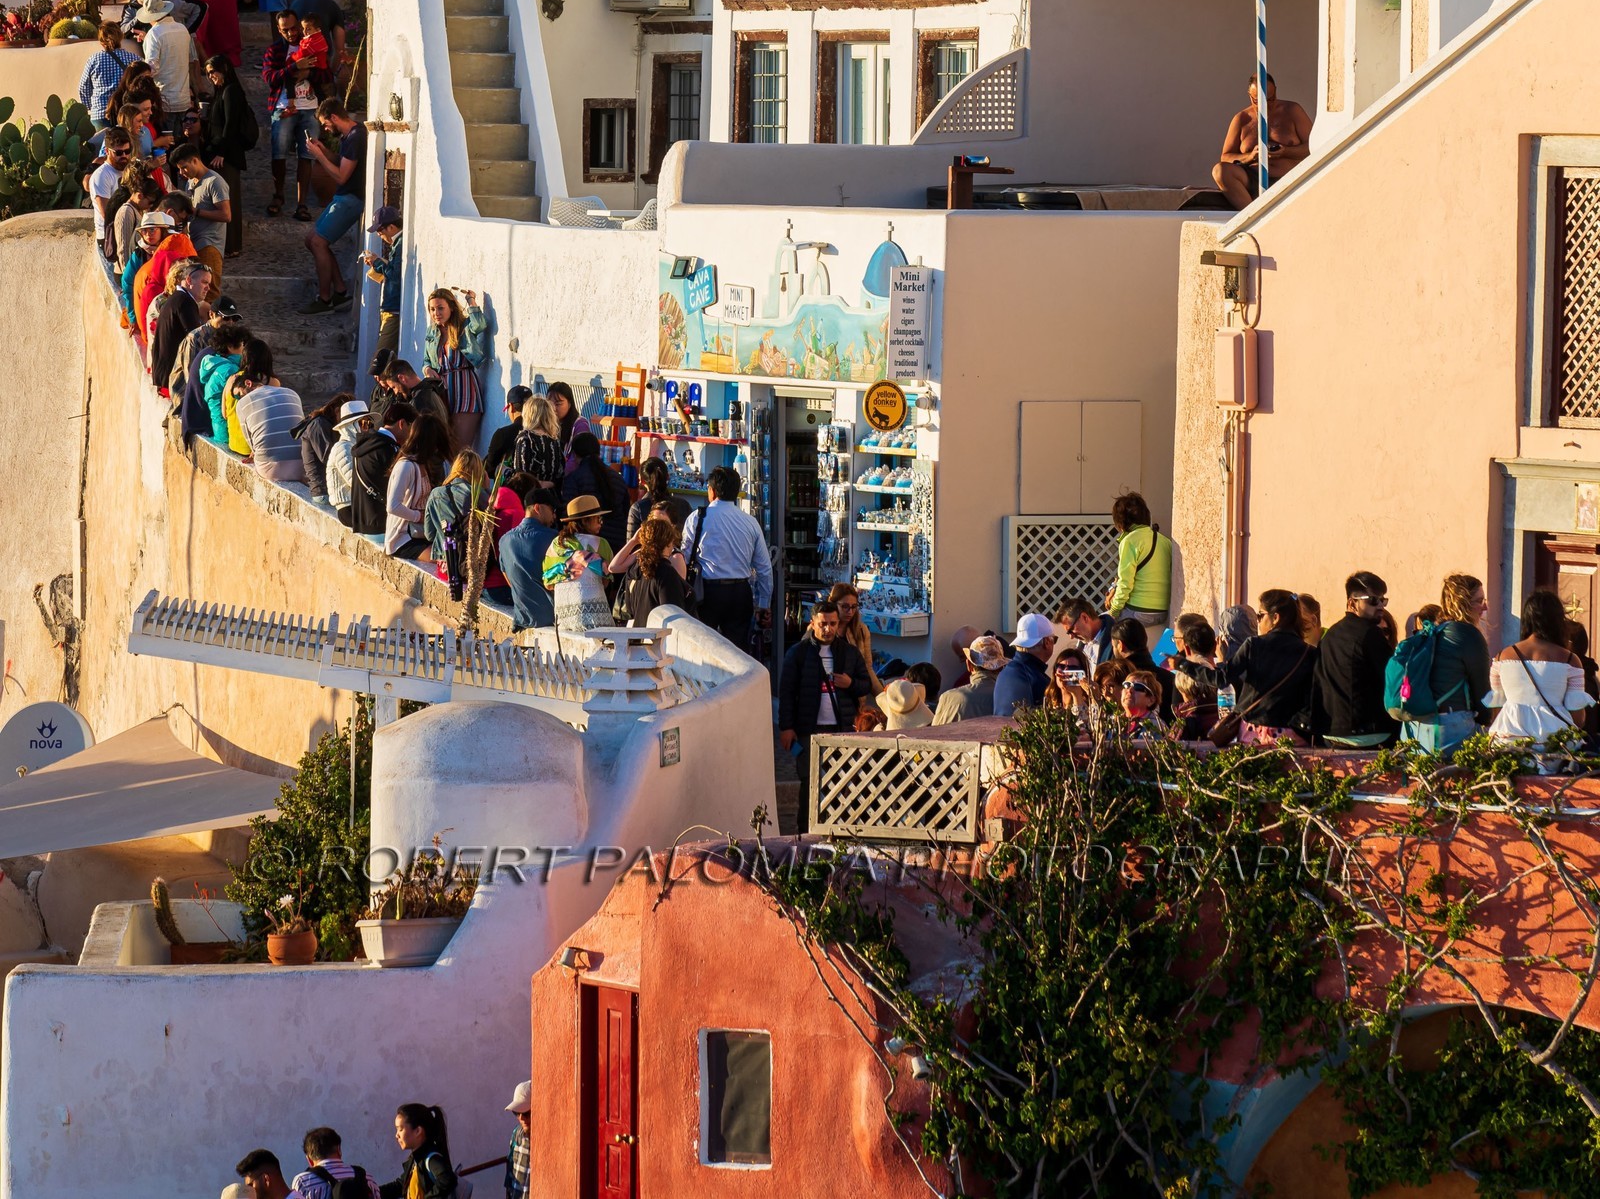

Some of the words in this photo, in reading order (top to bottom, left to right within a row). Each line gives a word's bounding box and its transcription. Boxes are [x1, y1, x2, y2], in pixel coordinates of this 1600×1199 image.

[900, 271, 920, 281] Mini
[893, 282, 925, 291] Market
[689, 285, 711, 308] CAVE
[729, 288, 743, 302] MINI
[902, 296, 915, 304] wines
[724, 304, 749, 321] MARKET
[893, 328, 921, 337] champagnes
[889, 338, 904, 346] sorbet
[905, 338, 925, 346] cocktails
[894, 359, 918, 367] traditional
[895, 370, 916, 379] products
[876, 391, 897, 399] yellow
[873, 398, 897, 407] donkey
[30, 739, 62, 749] nova
